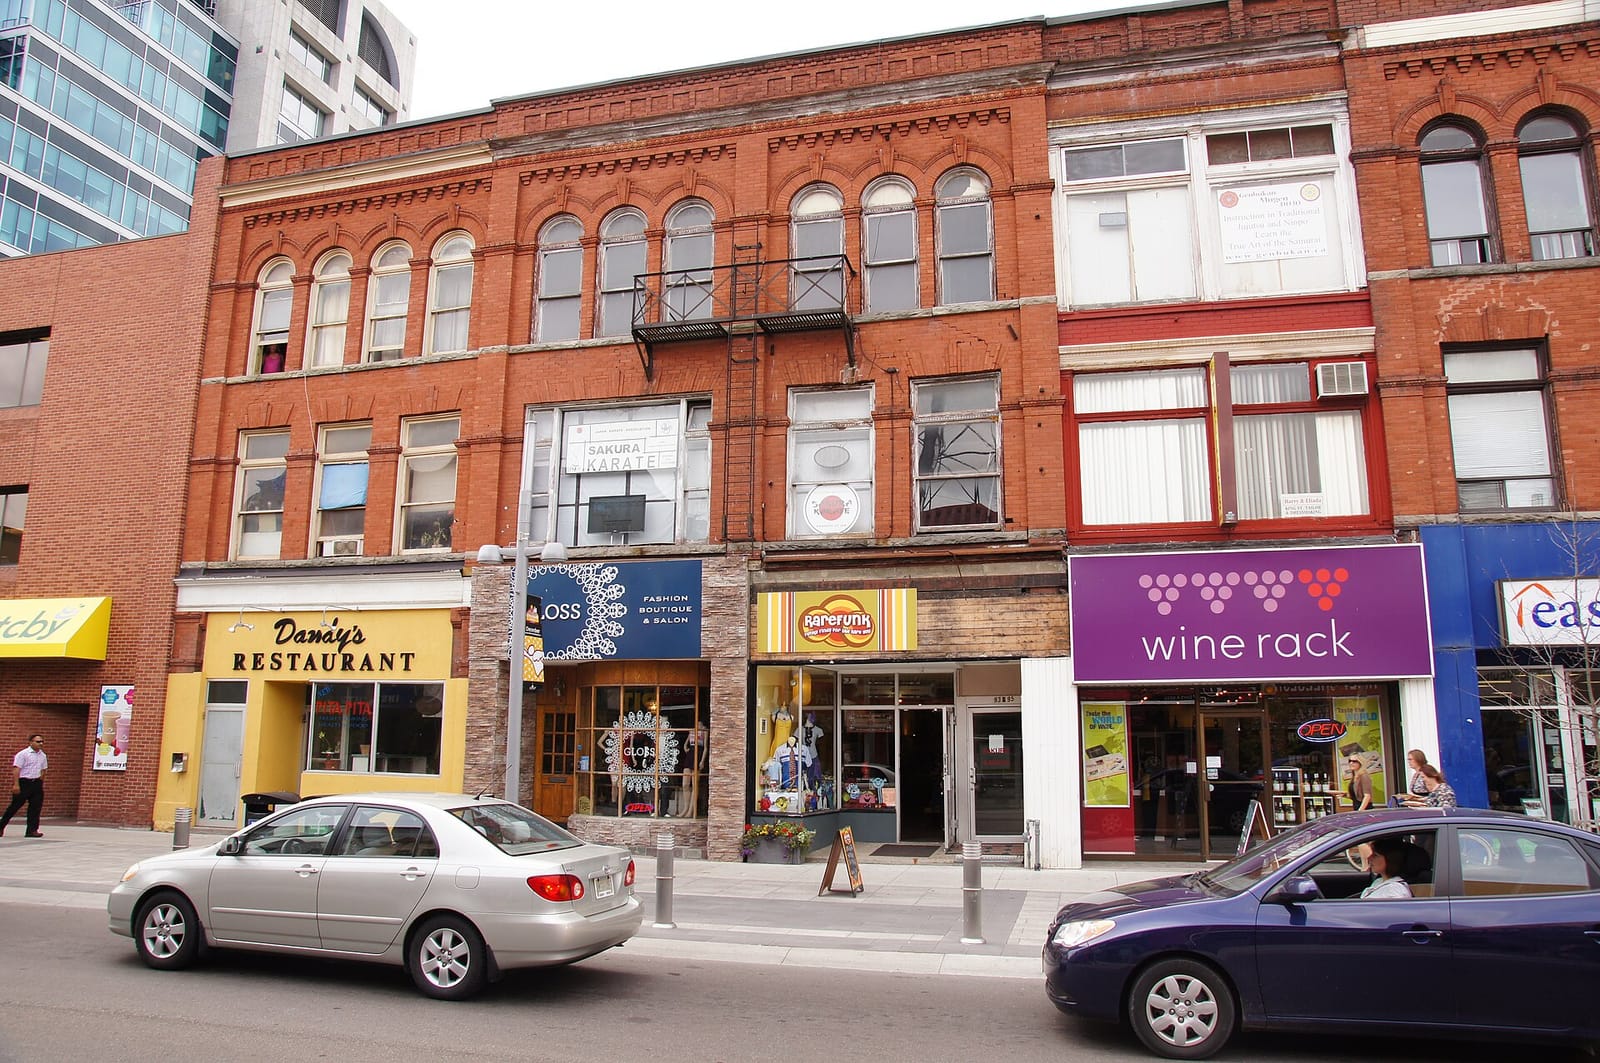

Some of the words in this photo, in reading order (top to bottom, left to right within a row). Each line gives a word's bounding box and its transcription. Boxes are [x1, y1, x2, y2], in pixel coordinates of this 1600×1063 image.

[1278, 207, 1320, 218] Traditional
[1267, 220, 1281, 228] and
[1255, 230, 1278, 239] Learn
[1248, 241, 1260, 249] Art
[1274, 238, 1286, 246] the
[1288, 237, 1321, 246] Samurai
[588, 444, 640, 456] SAKURA
[588, 456, 656, 471] KARATE
[643, 594, 688, 603] FASHION
[639, 605, 693, 614] BOUTIQUE
[654, 616, 689, 624] SALON
[274, 617, 366, 653] Dandy's
[1141, 626, 1246, 661] wine
[1258, 618, 1354, 658] rack
[232, 652, 416, 672] RESTAURANT
[316, 700, 342, 716] PITA
[345, 700, 372, 716] PITA
[1092, 716, 1122, 724] WORLD
[1300, 722, 1346, 737] OPEN
[624, 746, 656, 758] GLOSS
[627, 803, 654, 812] OPEN
